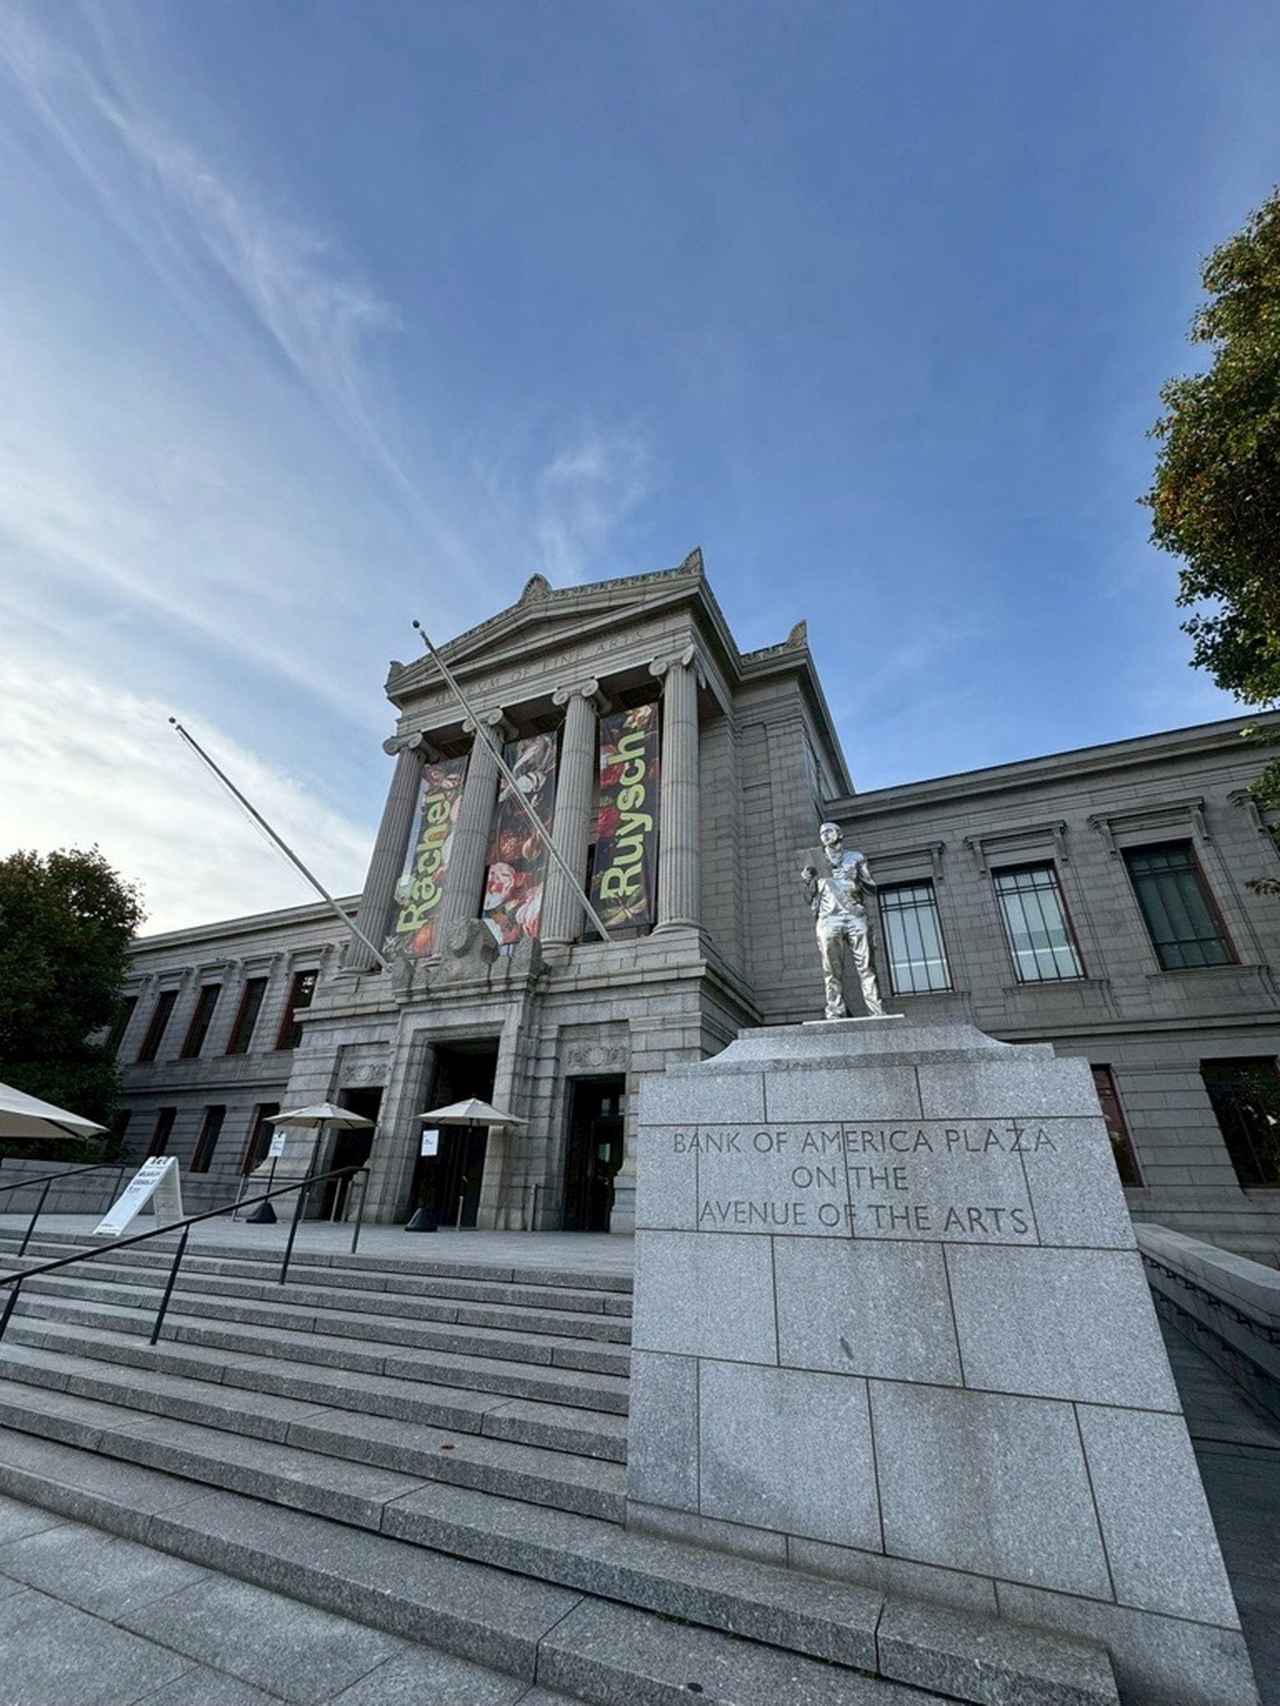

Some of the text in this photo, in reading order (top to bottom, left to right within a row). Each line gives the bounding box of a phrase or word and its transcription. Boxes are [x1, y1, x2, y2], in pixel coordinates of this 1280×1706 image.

[600, 730, 653, 900] Ruysch
[396, 793, 451, 934] Rachel
[673, 1128, 1058, 1154] BANK OF AMERICA PLAZA
[791, 1166, 908, 1190] ON THE
[699, 1201, 1028, 1235] AVENUE OF THE ARTS
